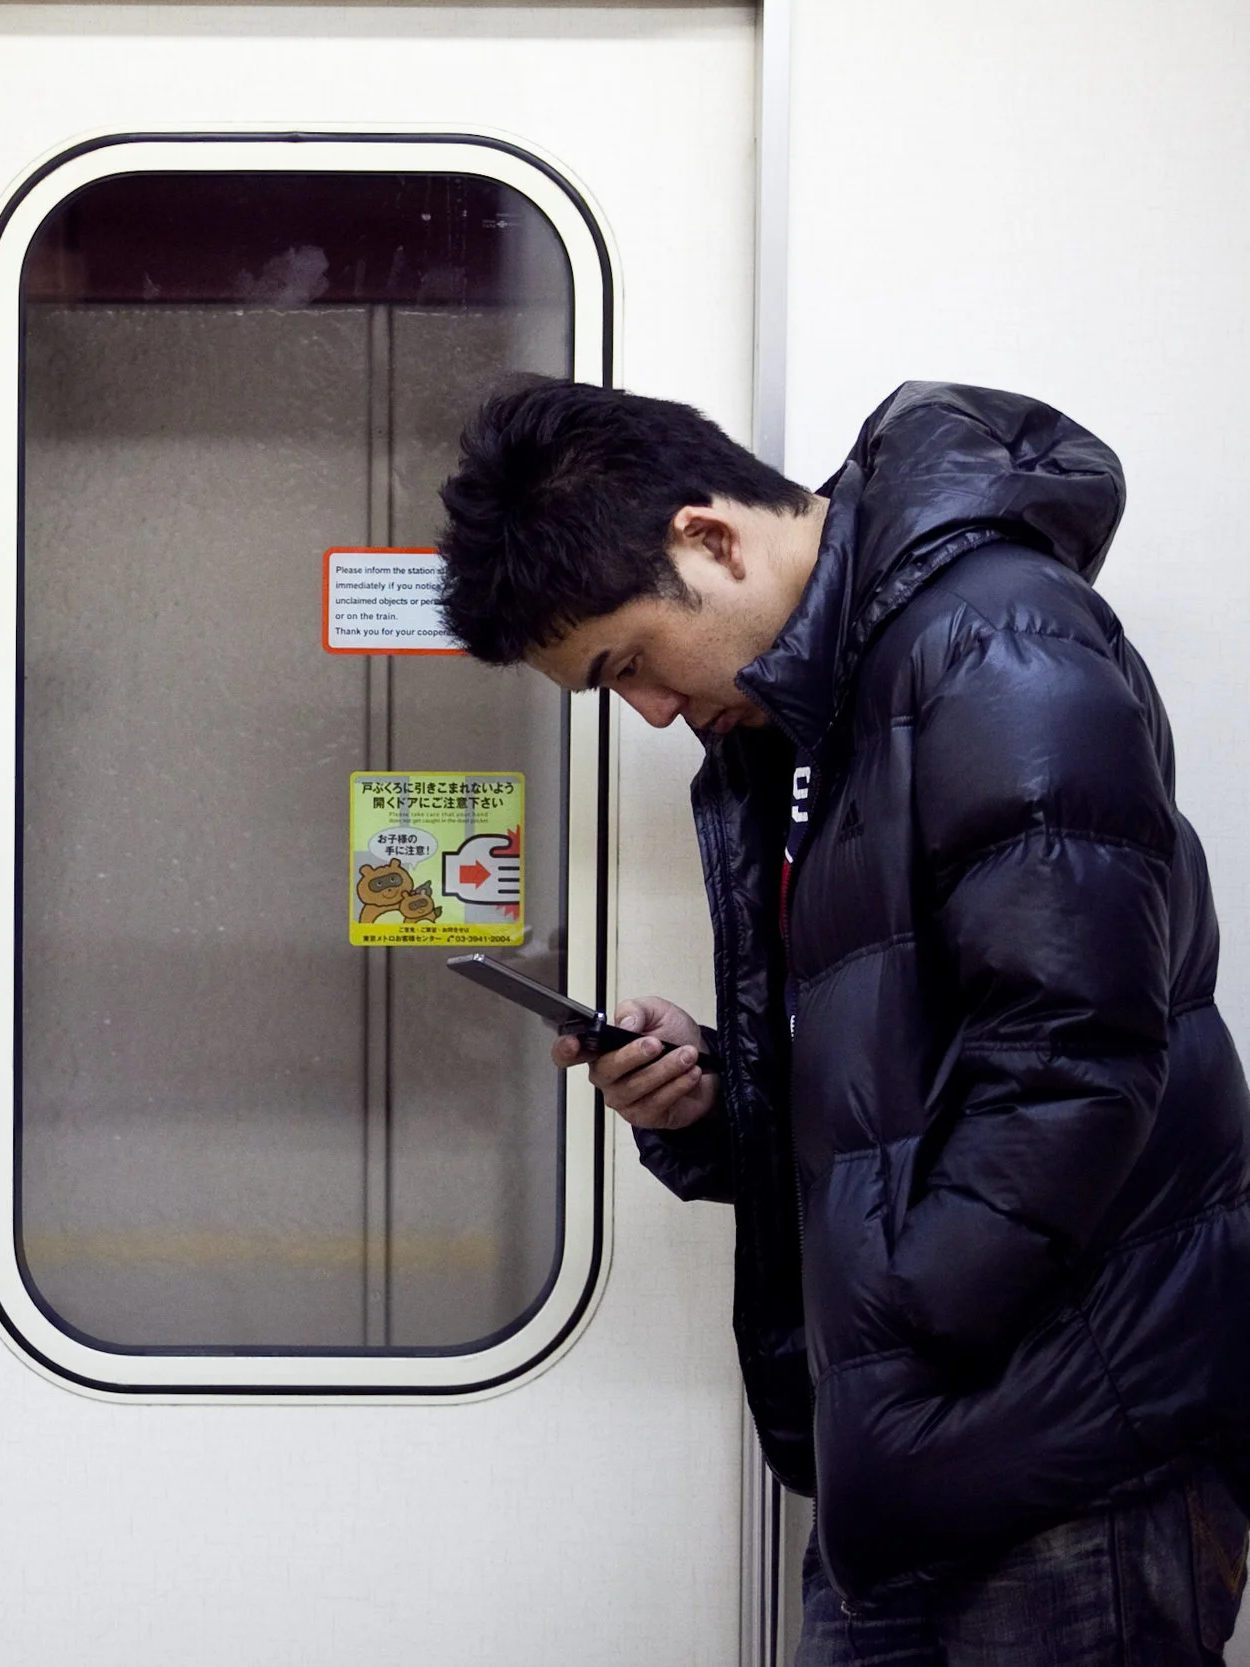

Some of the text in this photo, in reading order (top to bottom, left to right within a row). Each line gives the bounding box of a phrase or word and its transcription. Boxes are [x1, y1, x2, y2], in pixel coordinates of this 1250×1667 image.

[336, 566, 362, 574] Please
[364, 566, 390, 574] inform
[336, 582, 386, 592] immediately
[388, 582, 394, 590] if
[396, 584, 413, 592] you
[336, 597, 377, 605] unclaimed
[379, 597, 408, 606] objects
[360, 612, 374, 620] the
[376, 612, 398, 620] train.
[335, 627, 361, 636] Thank
[363, 629, 380, 638] you
[381, 627, 393, 636] for
[396, 629, 414, 638] your
[362, 782, 514, 795] 戸ぶくろに引きこまれないよう
[374, 796, 504, 810] 開くドアにご注意下さい
[378, 834, 418, 844] お子様の
